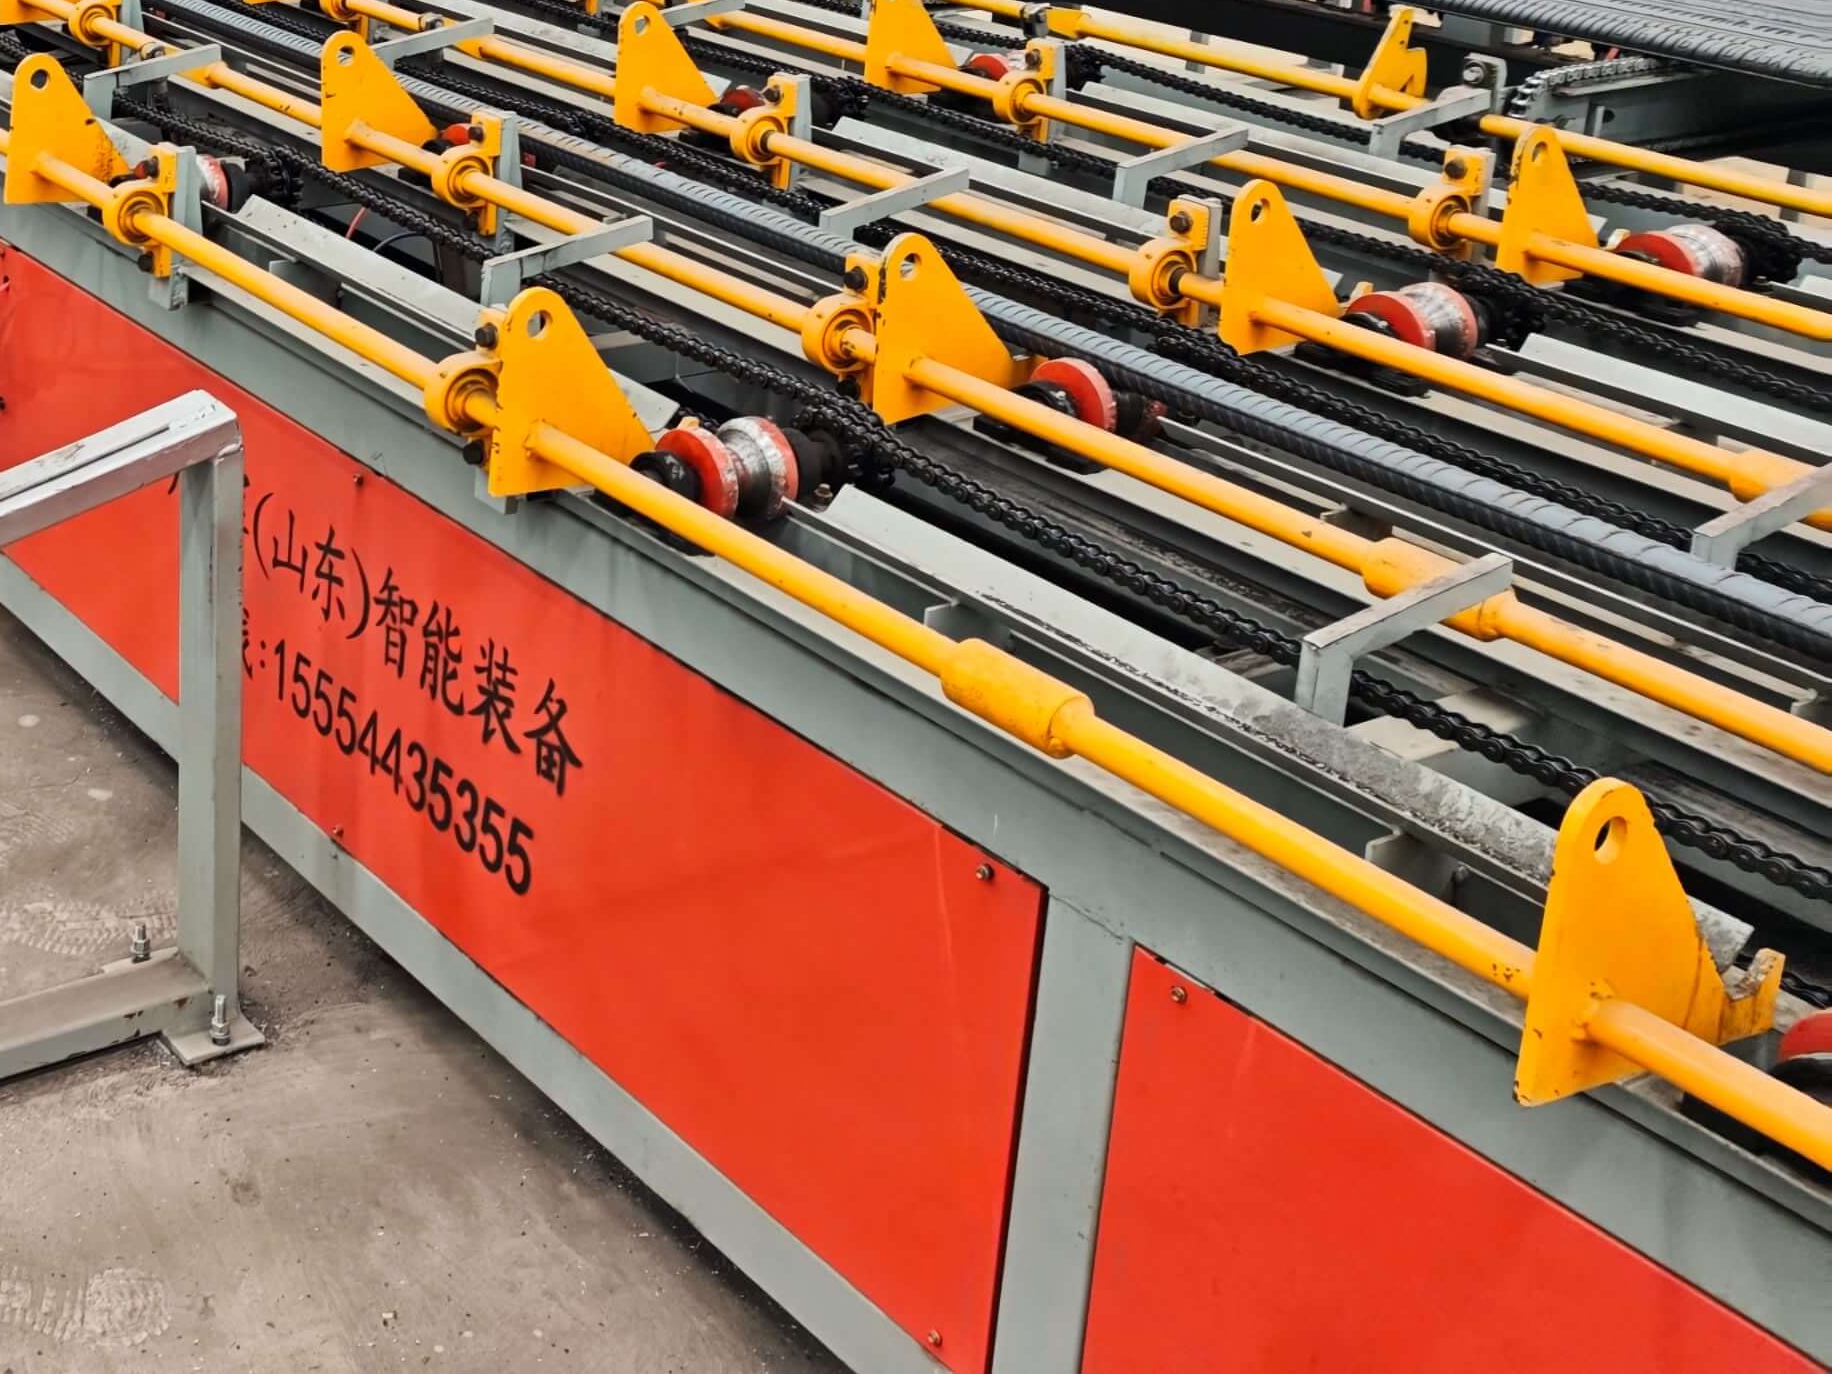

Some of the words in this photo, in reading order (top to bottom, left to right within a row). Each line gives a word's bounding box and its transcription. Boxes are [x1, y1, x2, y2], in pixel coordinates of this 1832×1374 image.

[246, 478, 584, 797] (山东)智能装备
